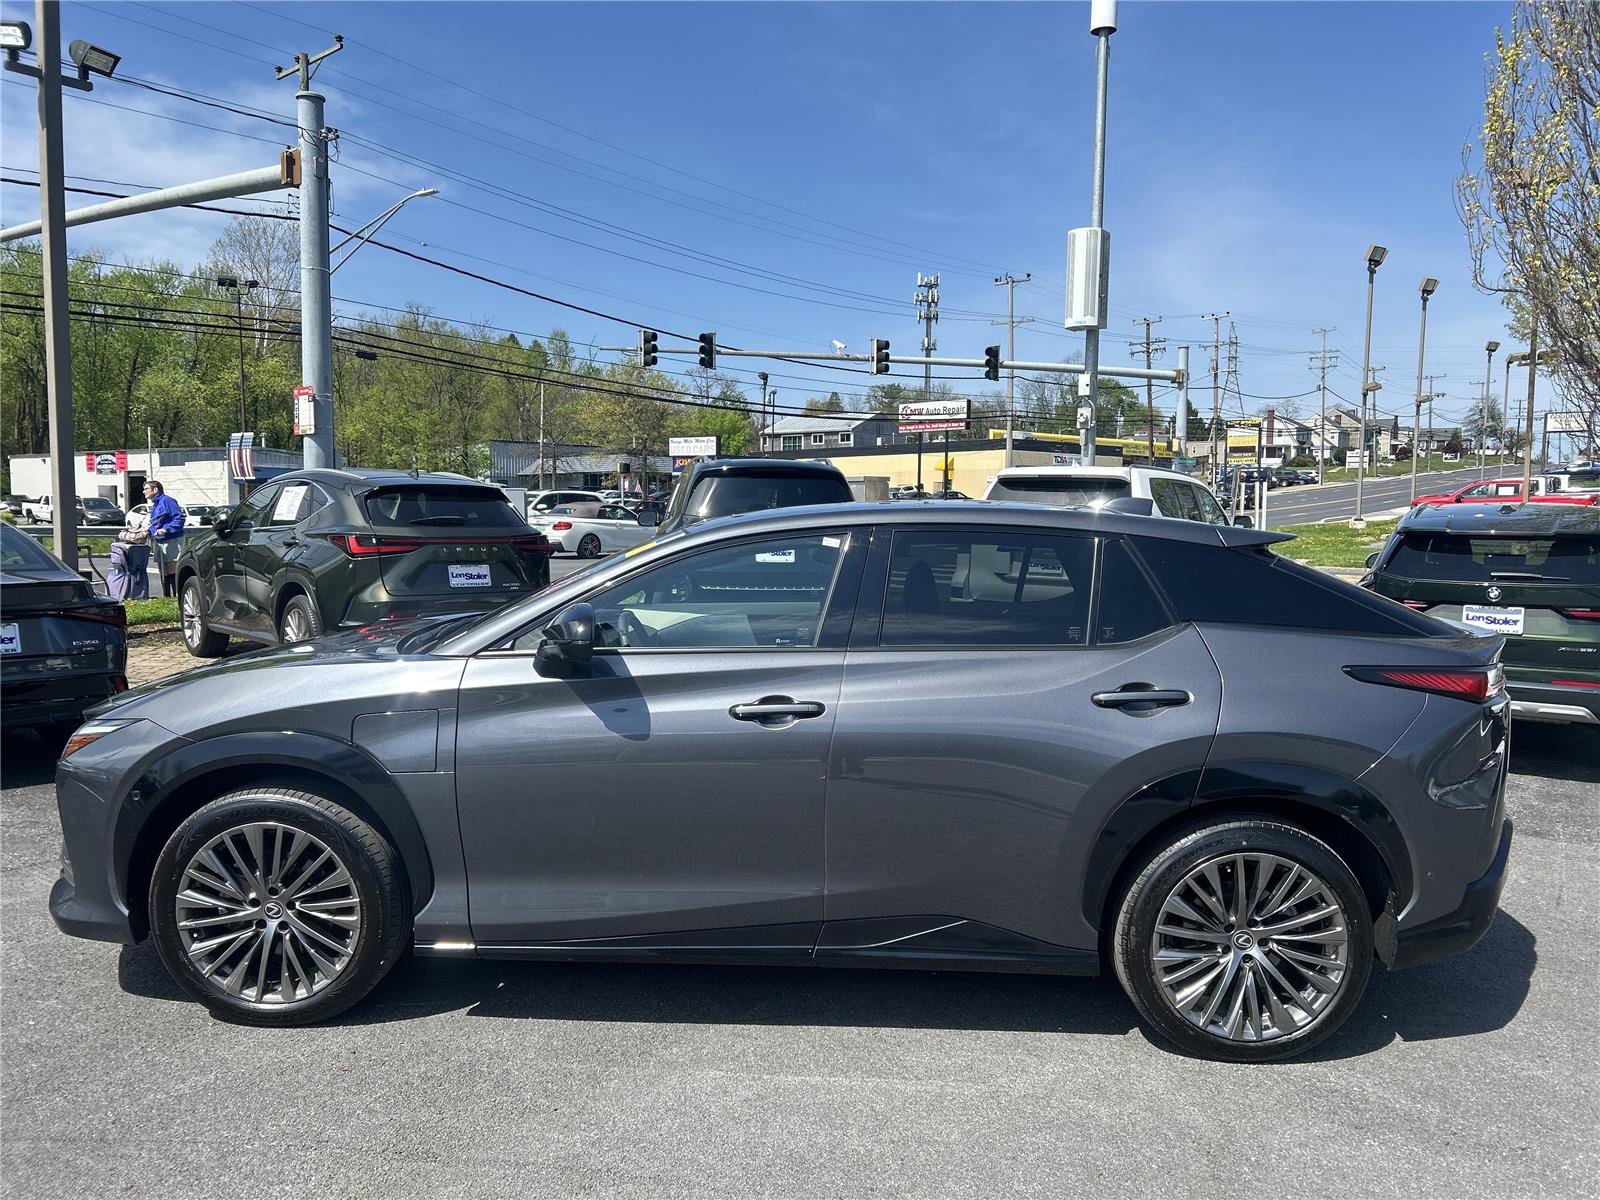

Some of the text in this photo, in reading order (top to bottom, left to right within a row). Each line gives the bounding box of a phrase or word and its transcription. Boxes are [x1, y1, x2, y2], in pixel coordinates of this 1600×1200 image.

[926, 407, 941, 415] Auto
[942, 405, 966, 417] Repair
[670, 444, 715, 454] USED CARS
